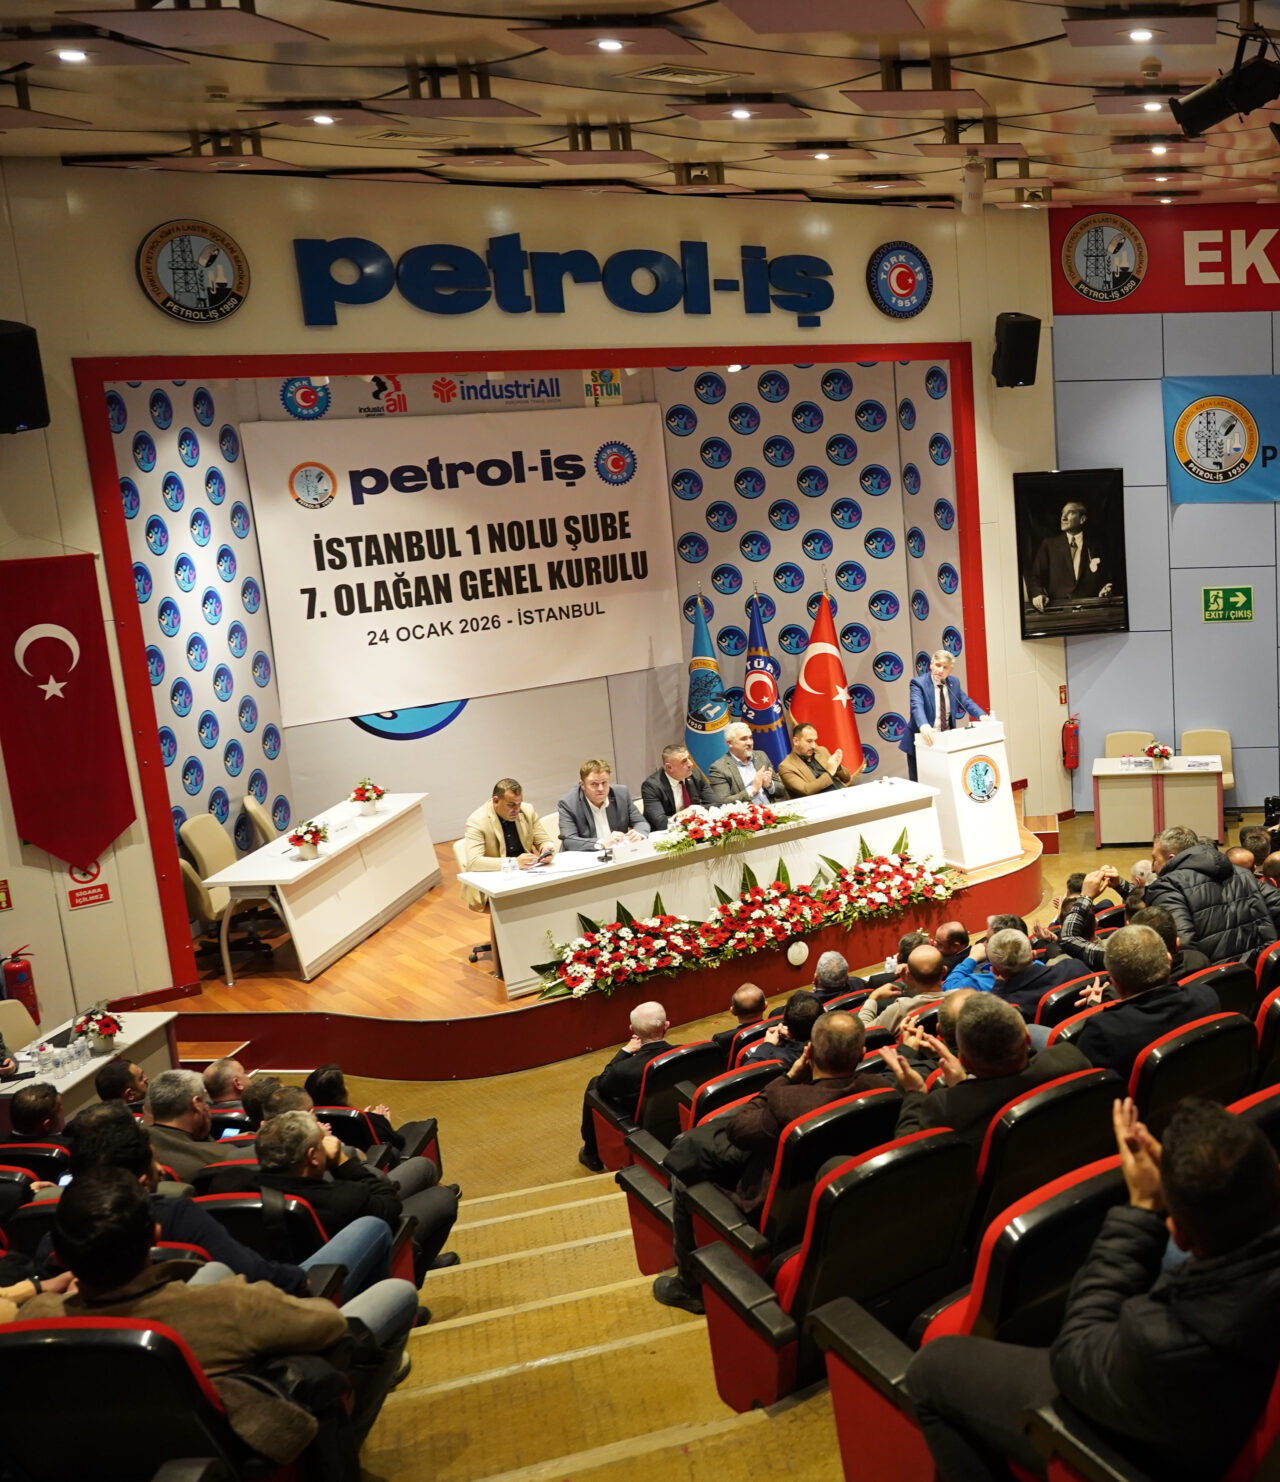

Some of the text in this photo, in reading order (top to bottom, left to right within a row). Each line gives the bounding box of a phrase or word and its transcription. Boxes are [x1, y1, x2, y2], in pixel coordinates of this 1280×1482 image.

[292, 232, 835, 328] petrol-iş
[1121, 280, 1136, 295] 1950
[220, 297, 238, 313] 1950
[892, 296, 917, 307] 1952
[459, 378, 561, 400] industriAll
[348, 449, 586, 505] petrol-iş
[1228, 464, 1246, 477] 1950
[313, 510, 632, 571] İSTANBUL 1 NOLU ŞUBE
[300, 550, 649, 620] 7. OLAĞAN GENEL KURULU
[367, 629, 390, 646] 24
[397, 620, 454, 643] OCAK
[459, 614, 501, 634] 2026
[517, 601, 605, 626] İSTANBUL
[1206, 611, 1224, 619] EXIT
